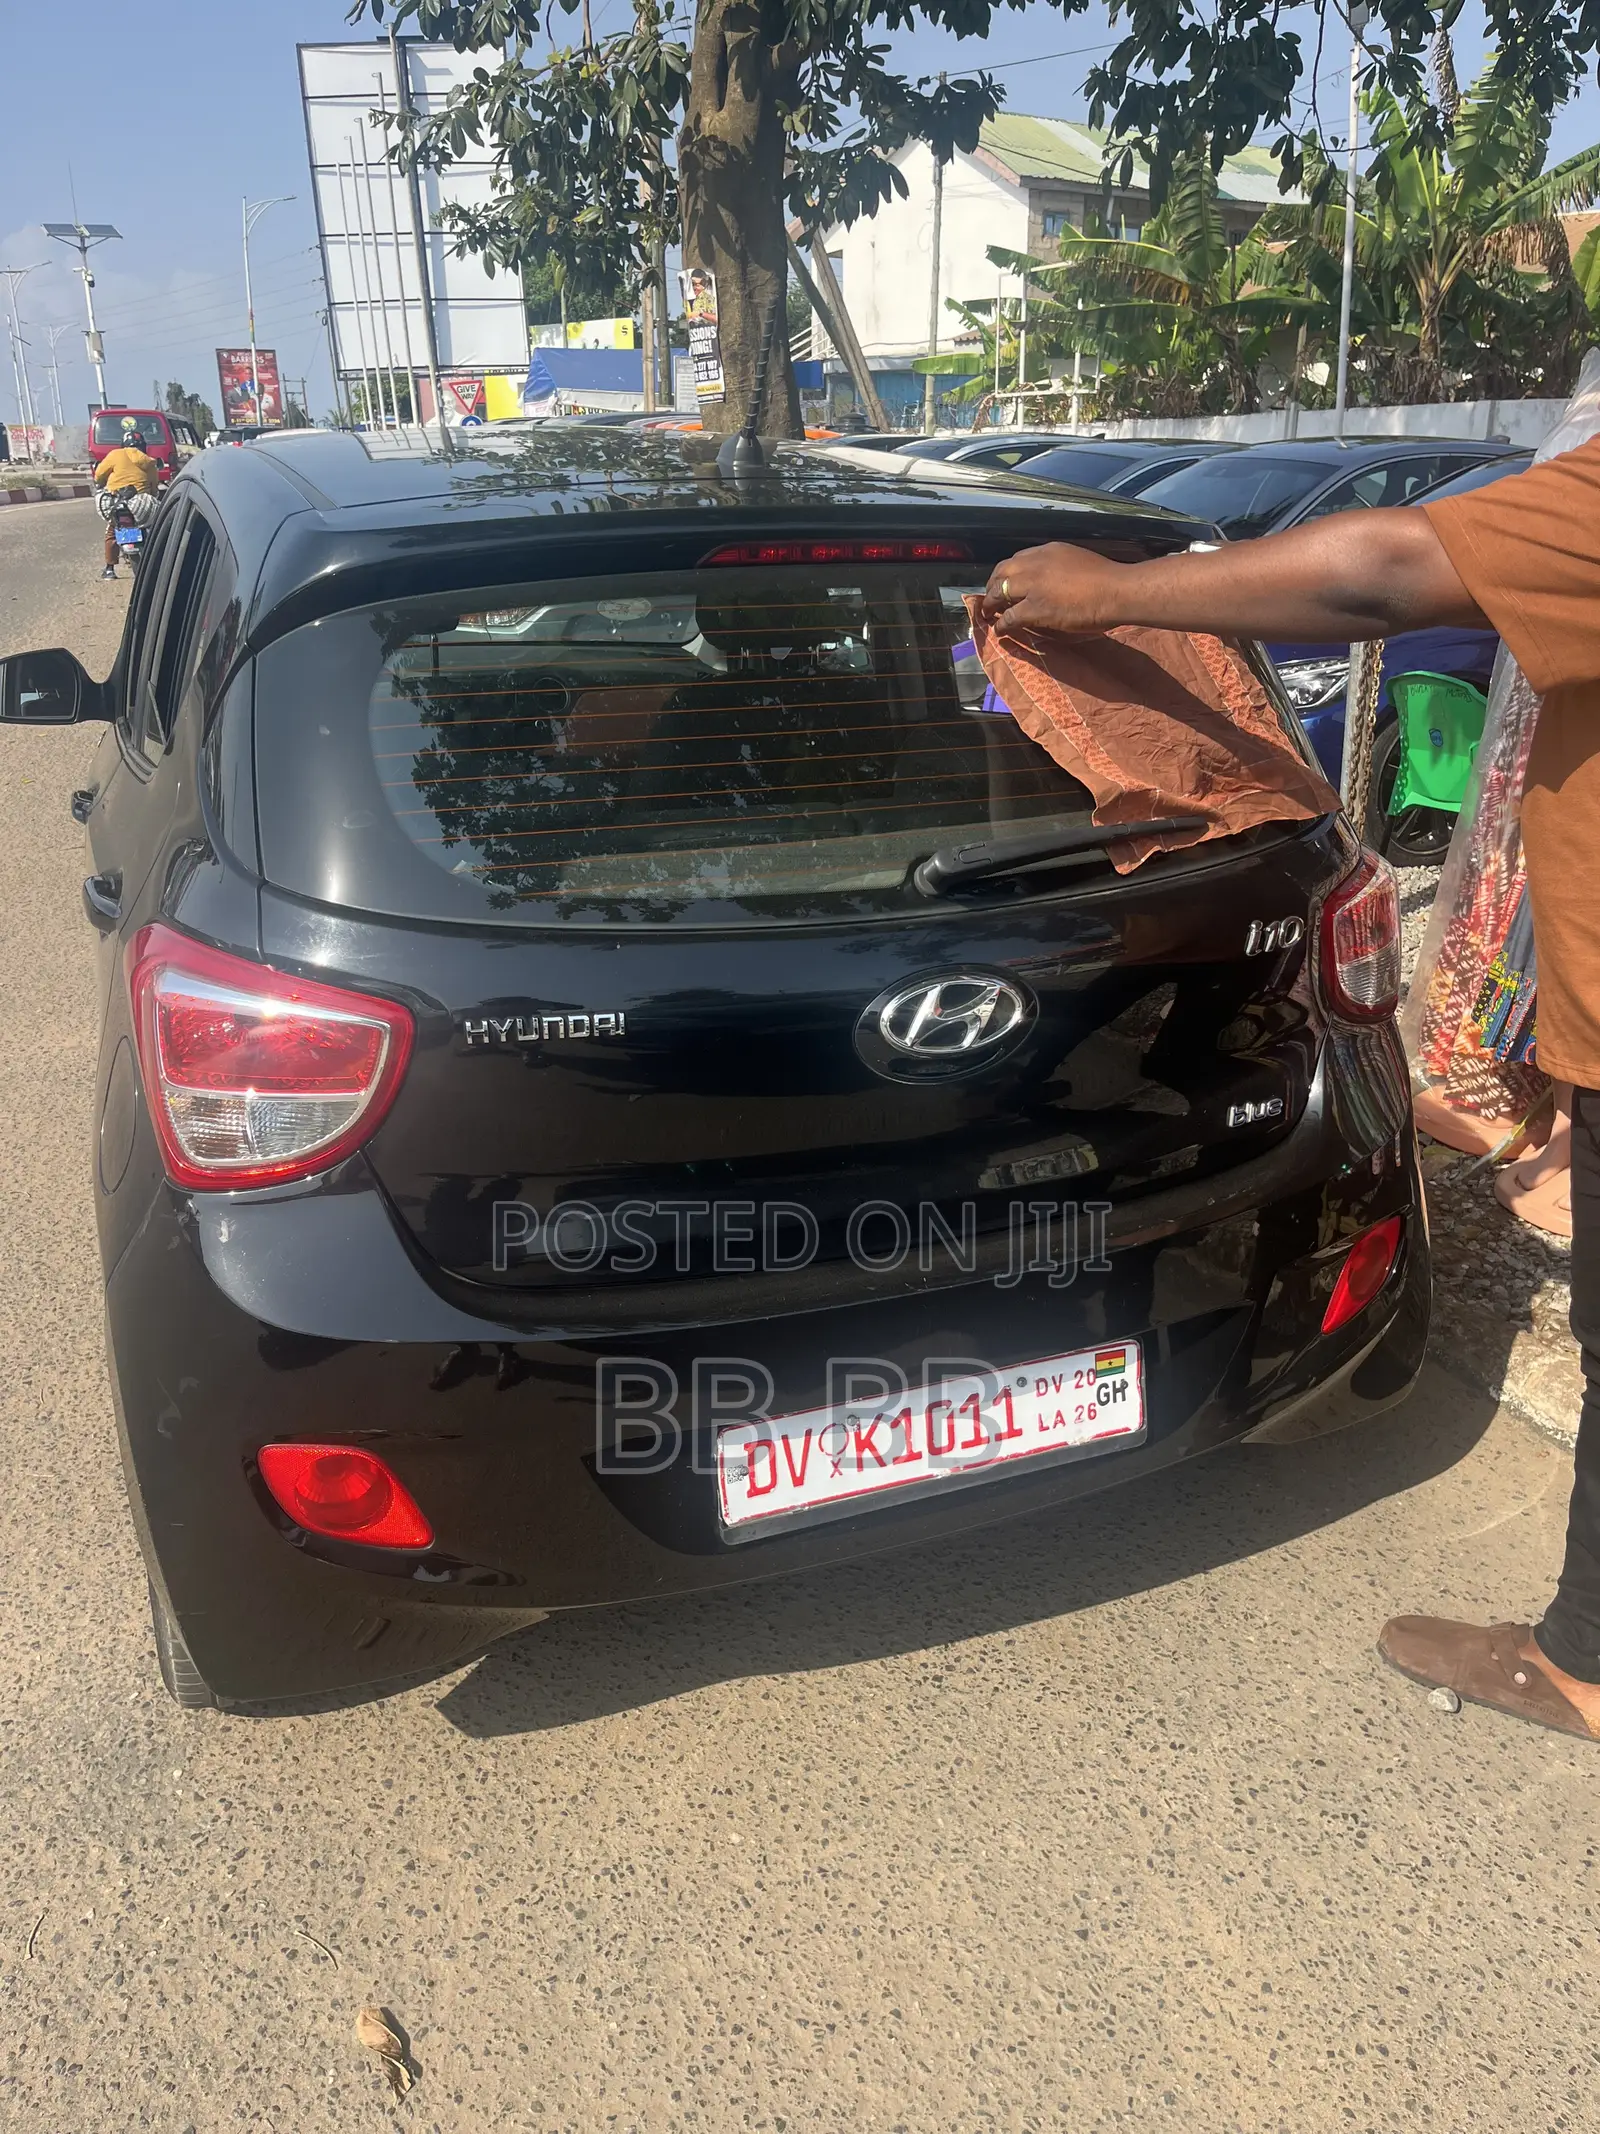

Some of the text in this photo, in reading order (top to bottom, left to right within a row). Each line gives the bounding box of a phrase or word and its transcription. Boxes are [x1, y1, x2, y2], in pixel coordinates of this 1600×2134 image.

[456, 384, 476, 394] GIVE
[1244, 915, 1305, 957] i10
[465, 1012, 626, 1045] HYUNDAI
[1226, 1097, 1284, 1128] blue
[1035, 1367, 1097, 1398] DV 20
[1096, 1380, 1127, 1407] GH
[1038, 1402, 1097, 1431] LA 26
